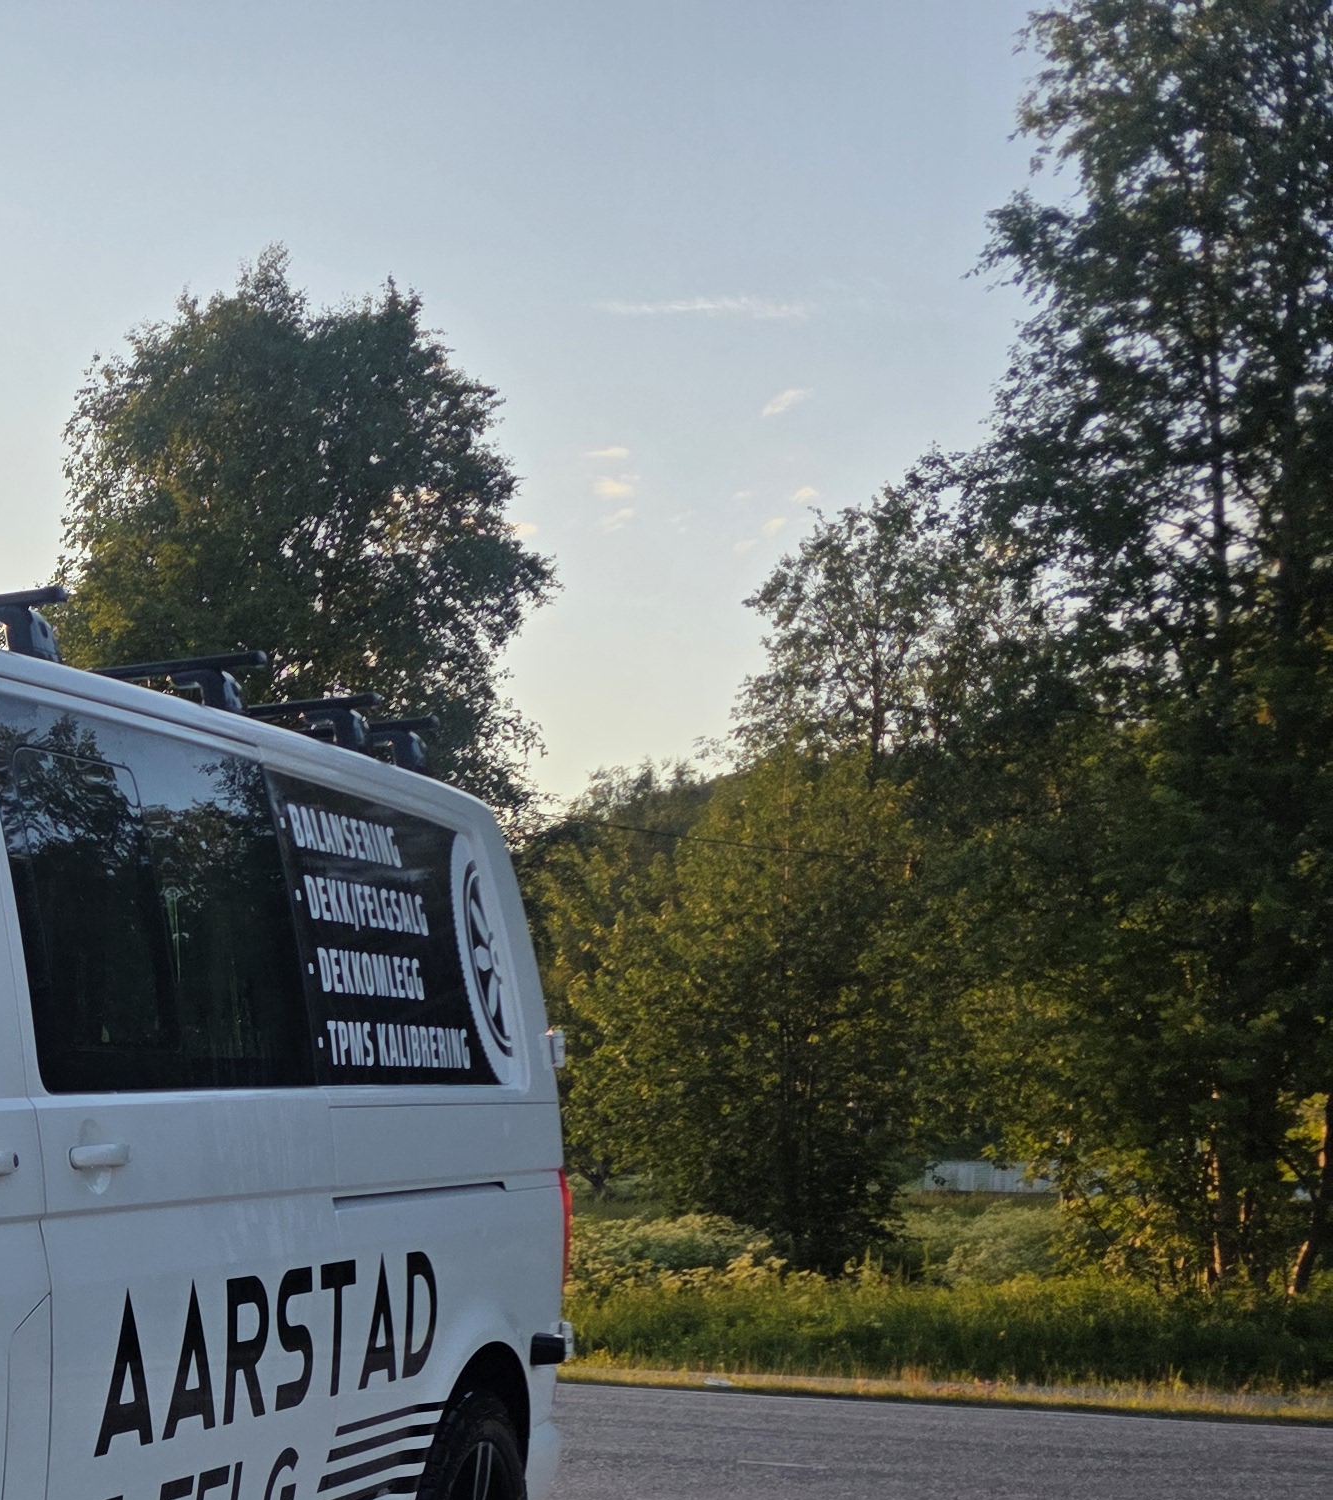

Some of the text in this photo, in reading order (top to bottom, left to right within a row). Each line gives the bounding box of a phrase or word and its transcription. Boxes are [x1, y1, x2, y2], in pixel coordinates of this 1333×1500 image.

[287, 803, 402, 868] BALANSERING
[303, 874, 429, 937] DEKK/FELGSALG
[316, 947, 425, 1001] DEKKOMLEGG
[326, 1020, 471, 1070] TPMS KALIBRERING
[93, 1250, 438, 1458] AARSTAD
